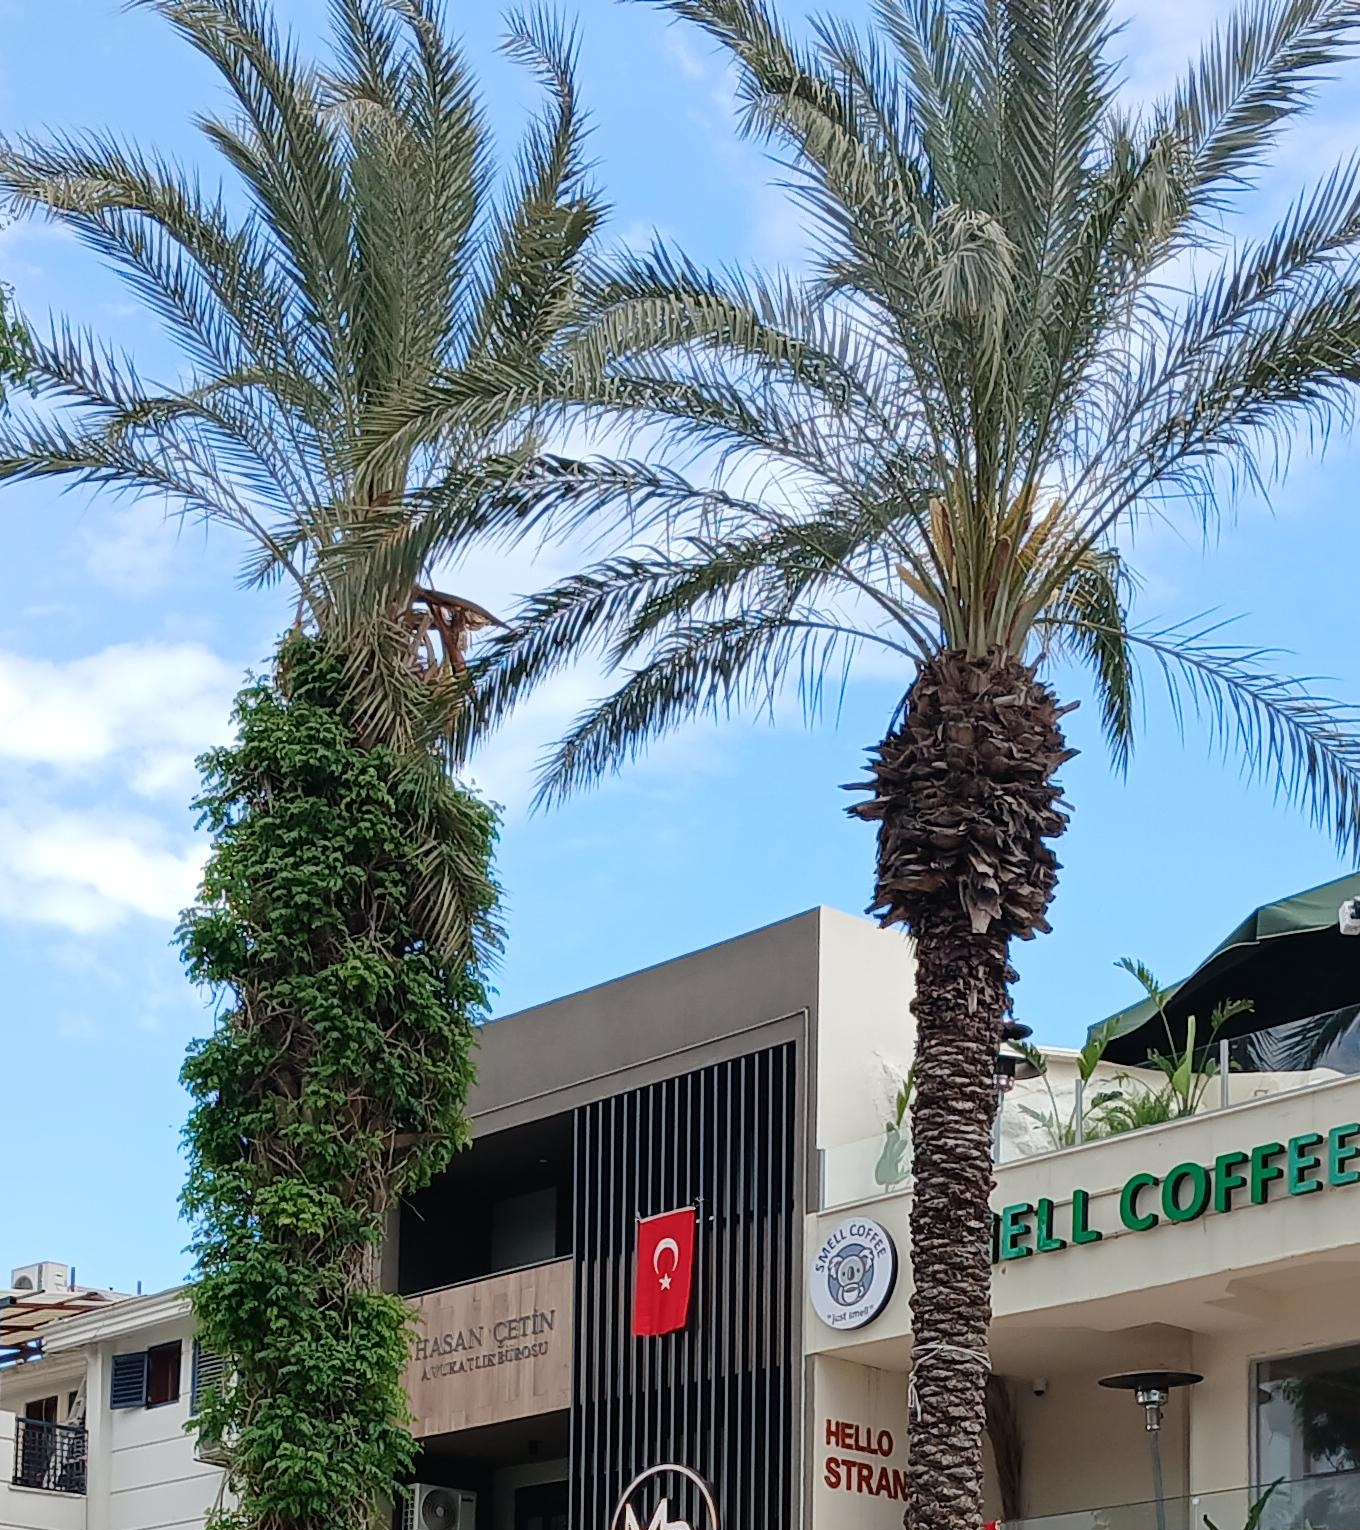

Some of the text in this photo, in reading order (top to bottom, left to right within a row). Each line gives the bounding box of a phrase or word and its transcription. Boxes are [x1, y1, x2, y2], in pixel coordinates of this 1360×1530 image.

[815, 1224, 887, 1273] SMELL COFFEE
[991, 1188, 1102, 1264] ELL
[415, 1308, 556, 1361] HASAN ÇETİN
[421, 1354, 497, 1382] AVUKATLIK
[825, 1418, 894, 1457] HELLO
[824, 1457, 909, 1502] STRAN
